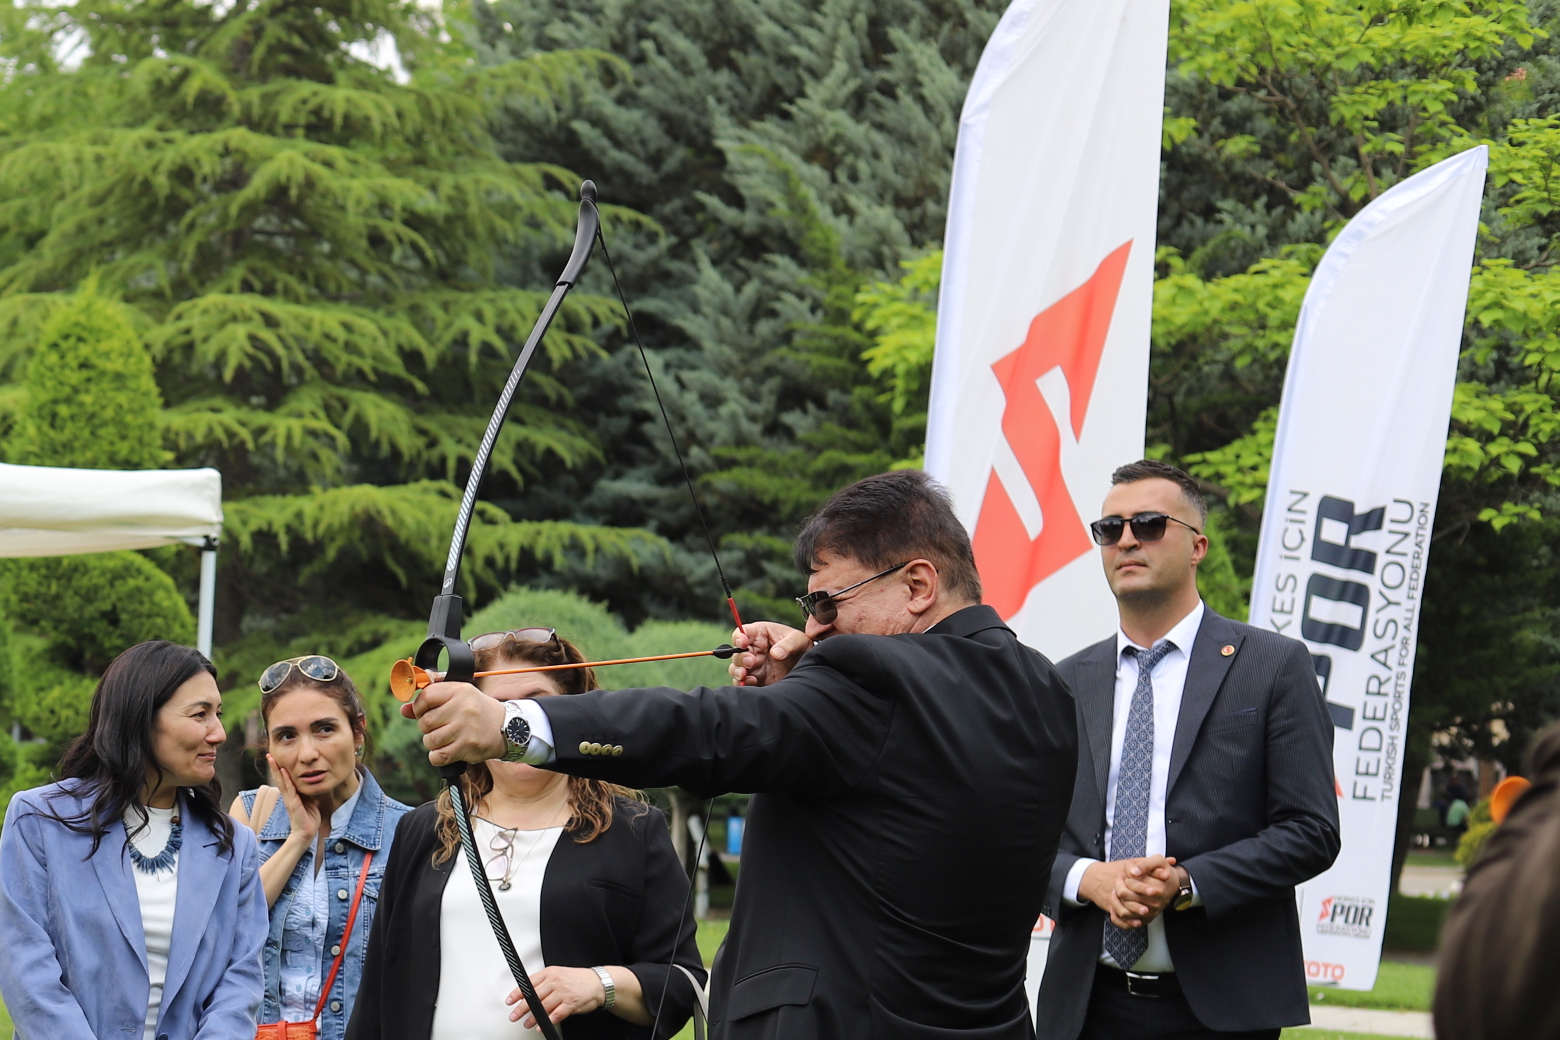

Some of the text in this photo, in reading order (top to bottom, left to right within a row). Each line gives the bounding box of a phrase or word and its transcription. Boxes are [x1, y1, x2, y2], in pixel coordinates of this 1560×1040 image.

[1301, 493, 1388, 733] POR
[1352, 498, 1415, 801] FEDERASYONU
[1381, 502, 1430, 802] TURKISH SPORTS FOR ALL FEDERATION
[1319, 894, 1374, 927] SPOR
